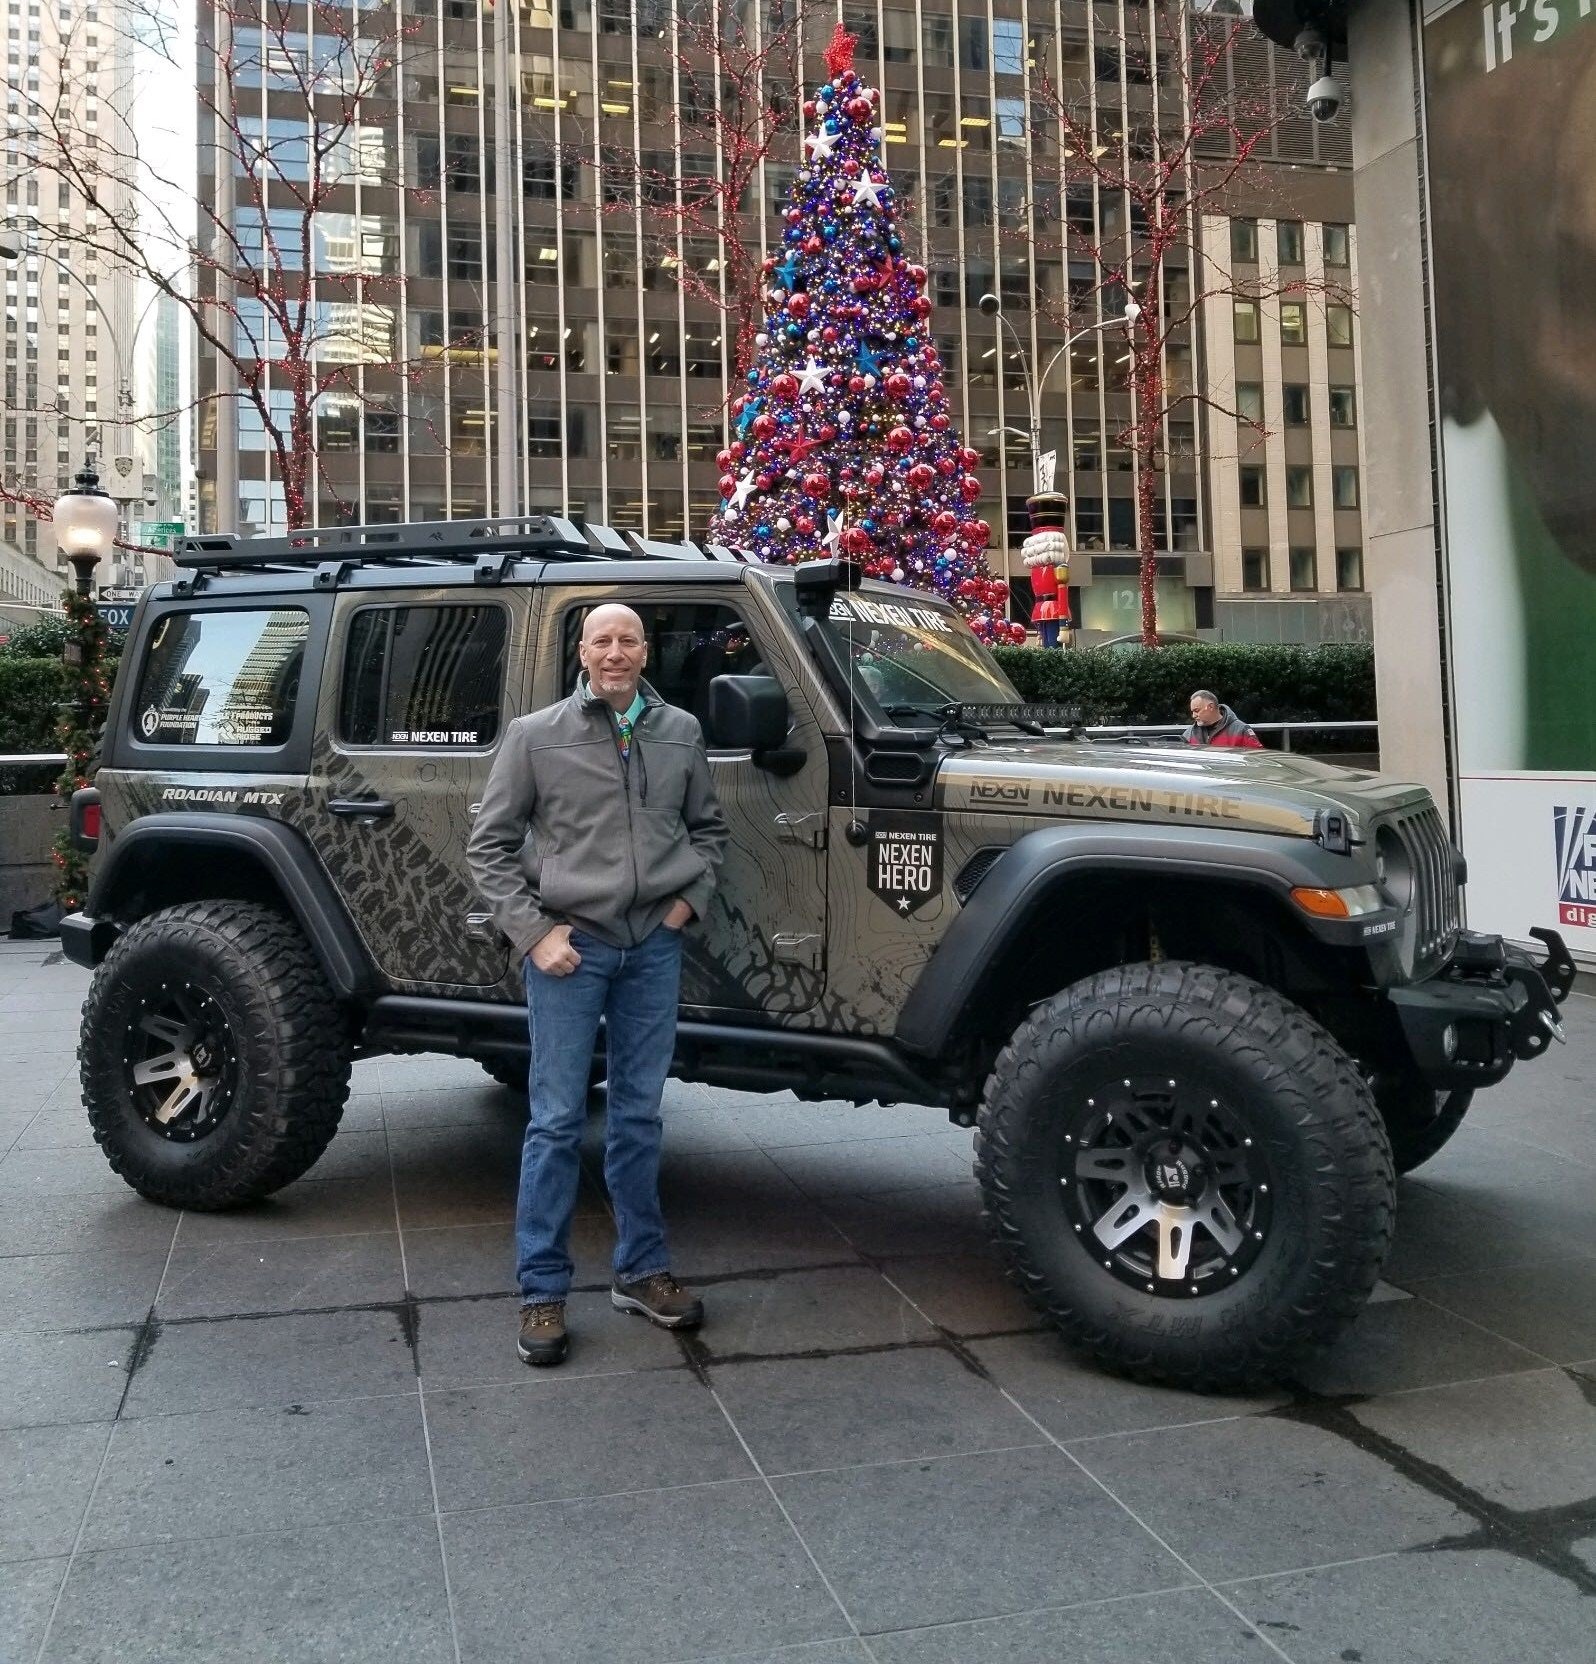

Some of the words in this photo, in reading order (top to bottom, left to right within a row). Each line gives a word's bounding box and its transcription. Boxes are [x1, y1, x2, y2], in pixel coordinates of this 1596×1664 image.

[1483, 0, 1559, 73] It's
[97, 609, 129, 625] FOX
[848, 599, 917, 628] NEXEN
[908, 607, 953, 633] TIRE
[182, 714, 200, 722] HEAR
[411, 731, 449, 742] NEXEN
[450, 731, 478, 743] TIRE
[162, 788, 238, 803] ROADIAN
[243, 791, 286, 805] MTX
[1042, 782, 1153, 812] NEXEN
[1164, 790, 1242, 820] TIRE
[888, 831, 917, 840] NEXEN
[917, 833, 937, 841] TIRE
[878, 843, 933, 866] NEXEN
[878, 864, 932, 892] HERO
